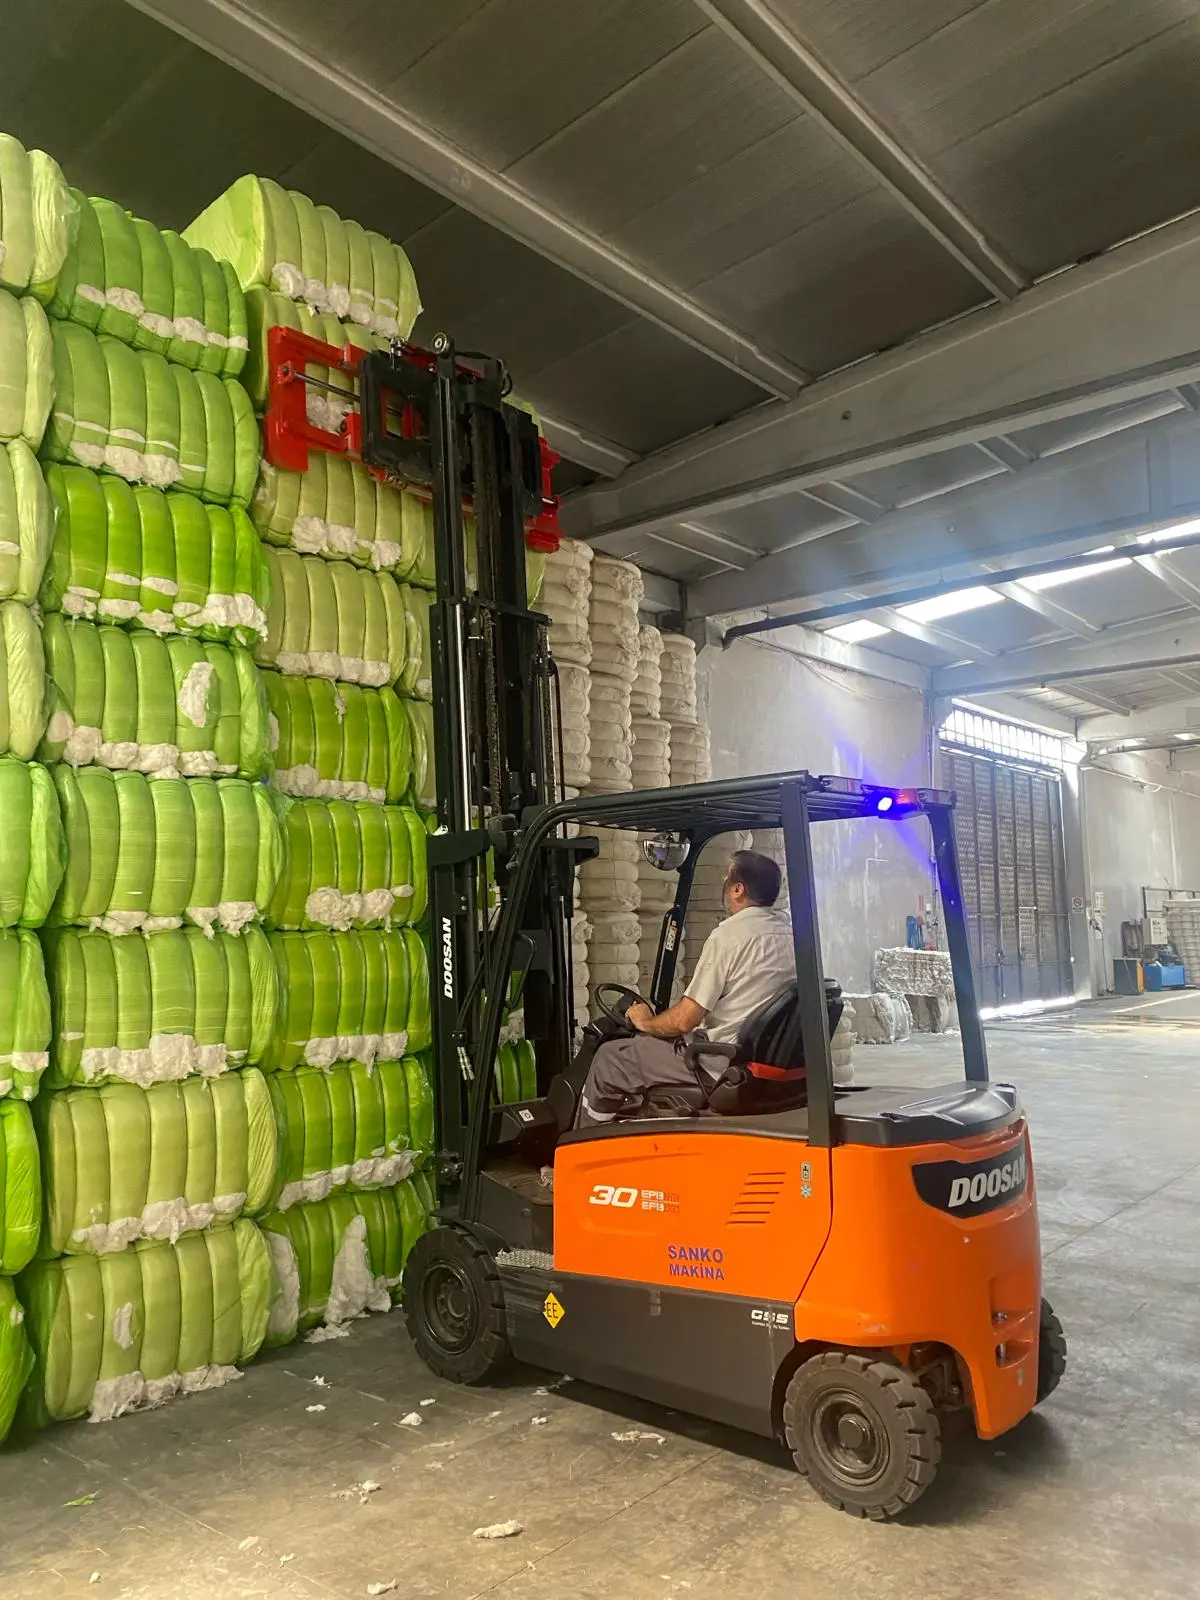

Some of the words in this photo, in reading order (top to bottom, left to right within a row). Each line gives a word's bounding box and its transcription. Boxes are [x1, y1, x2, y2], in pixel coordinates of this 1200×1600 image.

[442, 917, 453, 999] DOOSAN
[589, 1185, 638, 1208] 30
[668, 1245, 724, 1264] SANKO
[669, 1263, 725, 1280] MAKİNA
